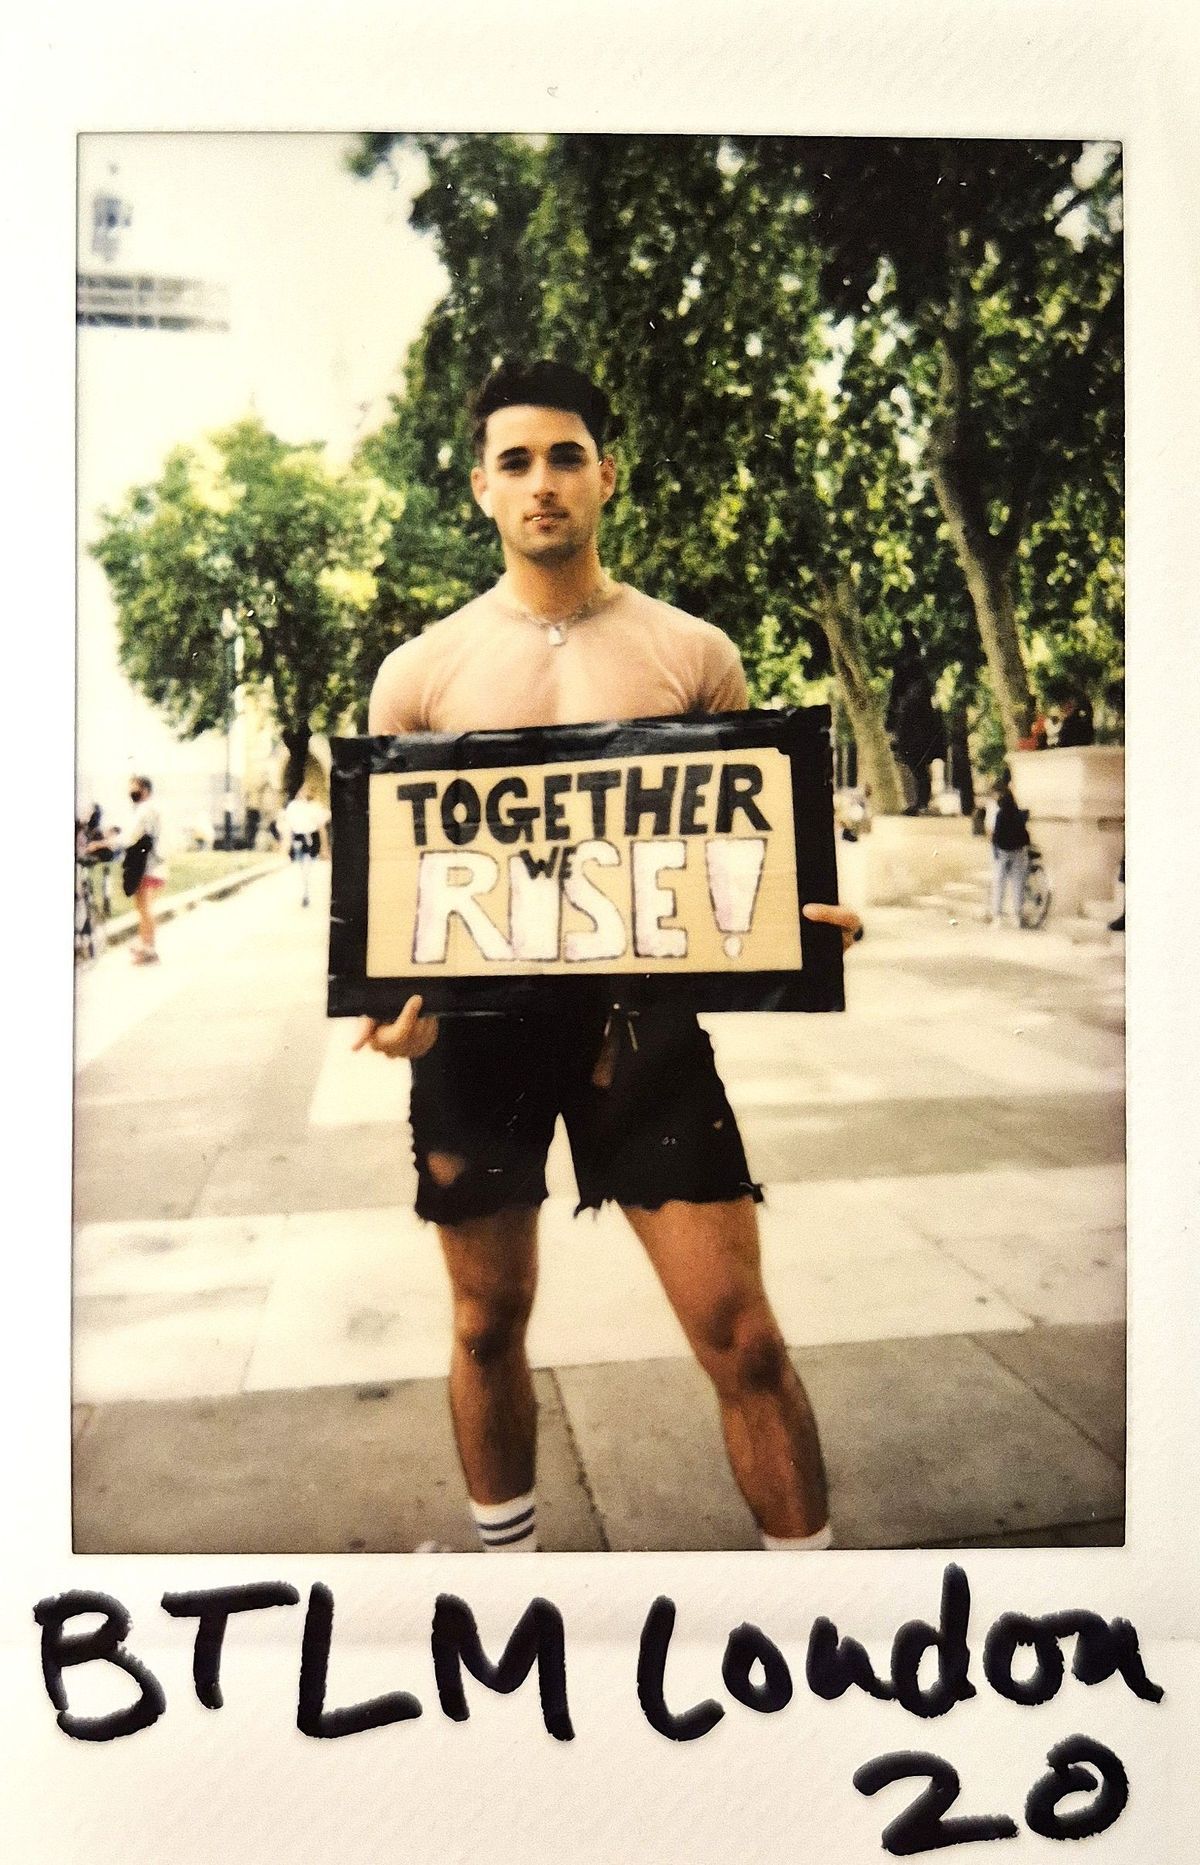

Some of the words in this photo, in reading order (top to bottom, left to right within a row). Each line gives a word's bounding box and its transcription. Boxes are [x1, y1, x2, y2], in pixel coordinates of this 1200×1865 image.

[397, 763, 772, 846] TOGETHER
[519, 844, 576, 881] WE
[411, 838, 768, 965] RISE!
[32, 1580, 574, 1742] BTLM
[636, 1562, 1165, 1742] London
[852, 1733, 1132, 1855] 20
